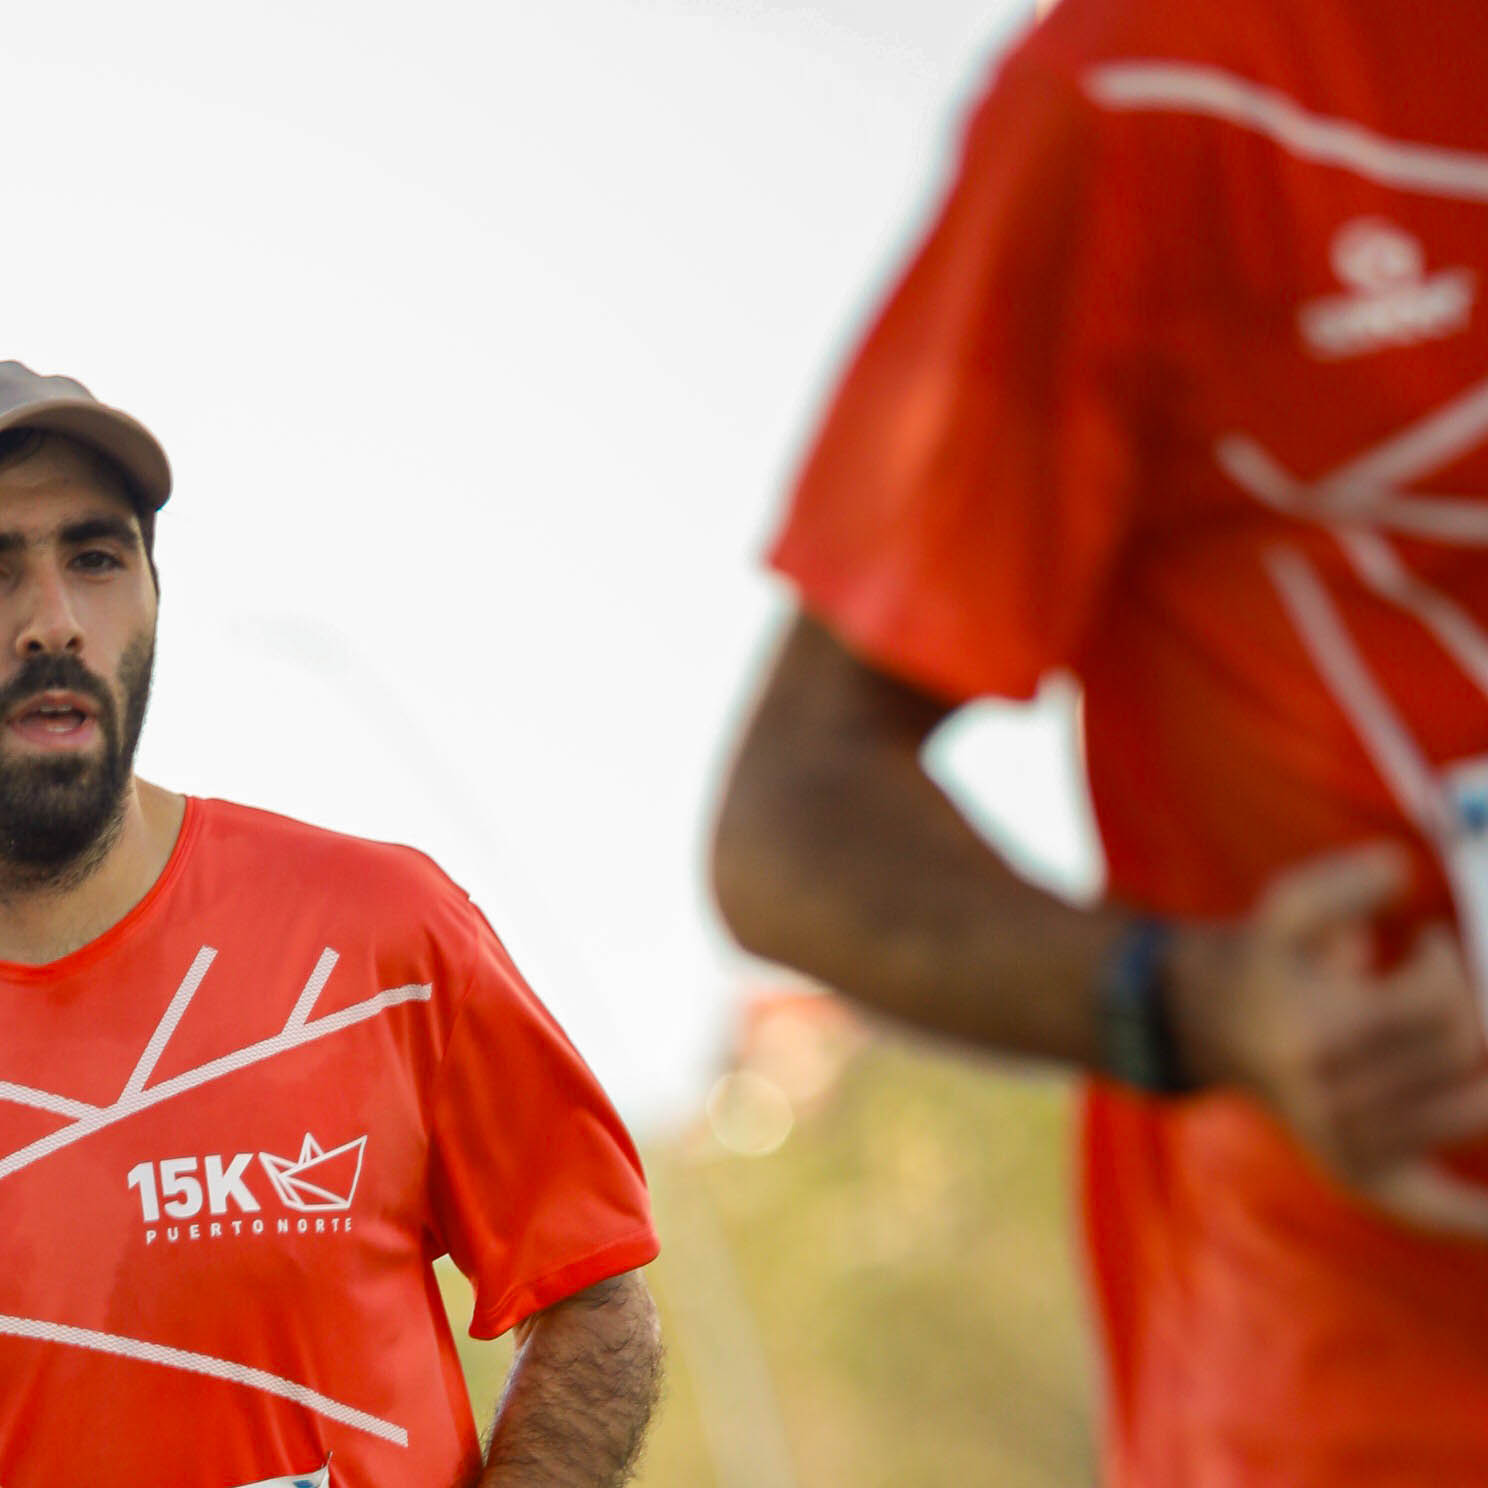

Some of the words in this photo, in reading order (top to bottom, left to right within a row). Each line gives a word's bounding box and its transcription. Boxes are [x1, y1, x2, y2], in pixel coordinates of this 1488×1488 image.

[127, 1153, 261, 1223] 15K
[146, 1219, 264, 1246] PUERTO
[277, 1217, 353, 1236] NORTE
